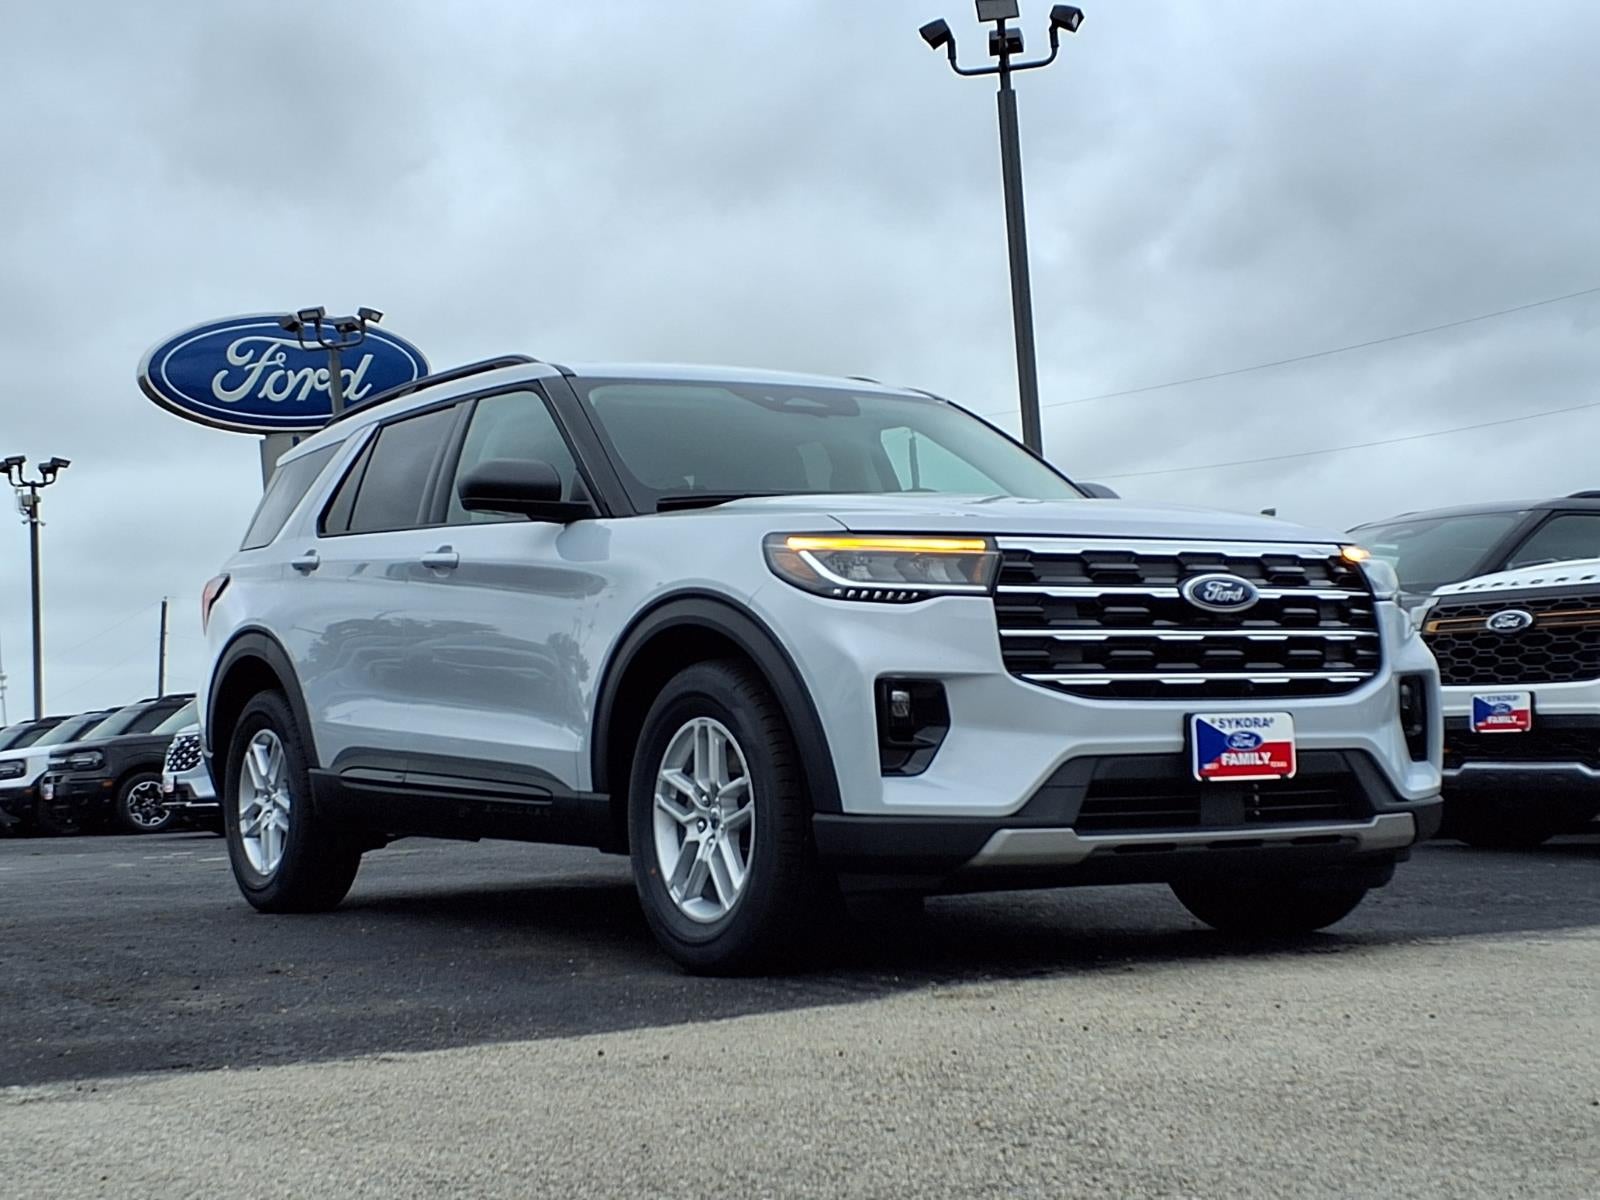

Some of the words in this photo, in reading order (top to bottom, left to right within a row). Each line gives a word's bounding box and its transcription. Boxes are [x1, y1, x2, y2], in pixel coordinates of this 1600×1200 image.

[211, 335, 374, 402] Ford
[1203, 580, 1244, 601] Ford
[1494, 614, 1520, 628] Ford
[1220, 751, 1272, 766] FAMILY
